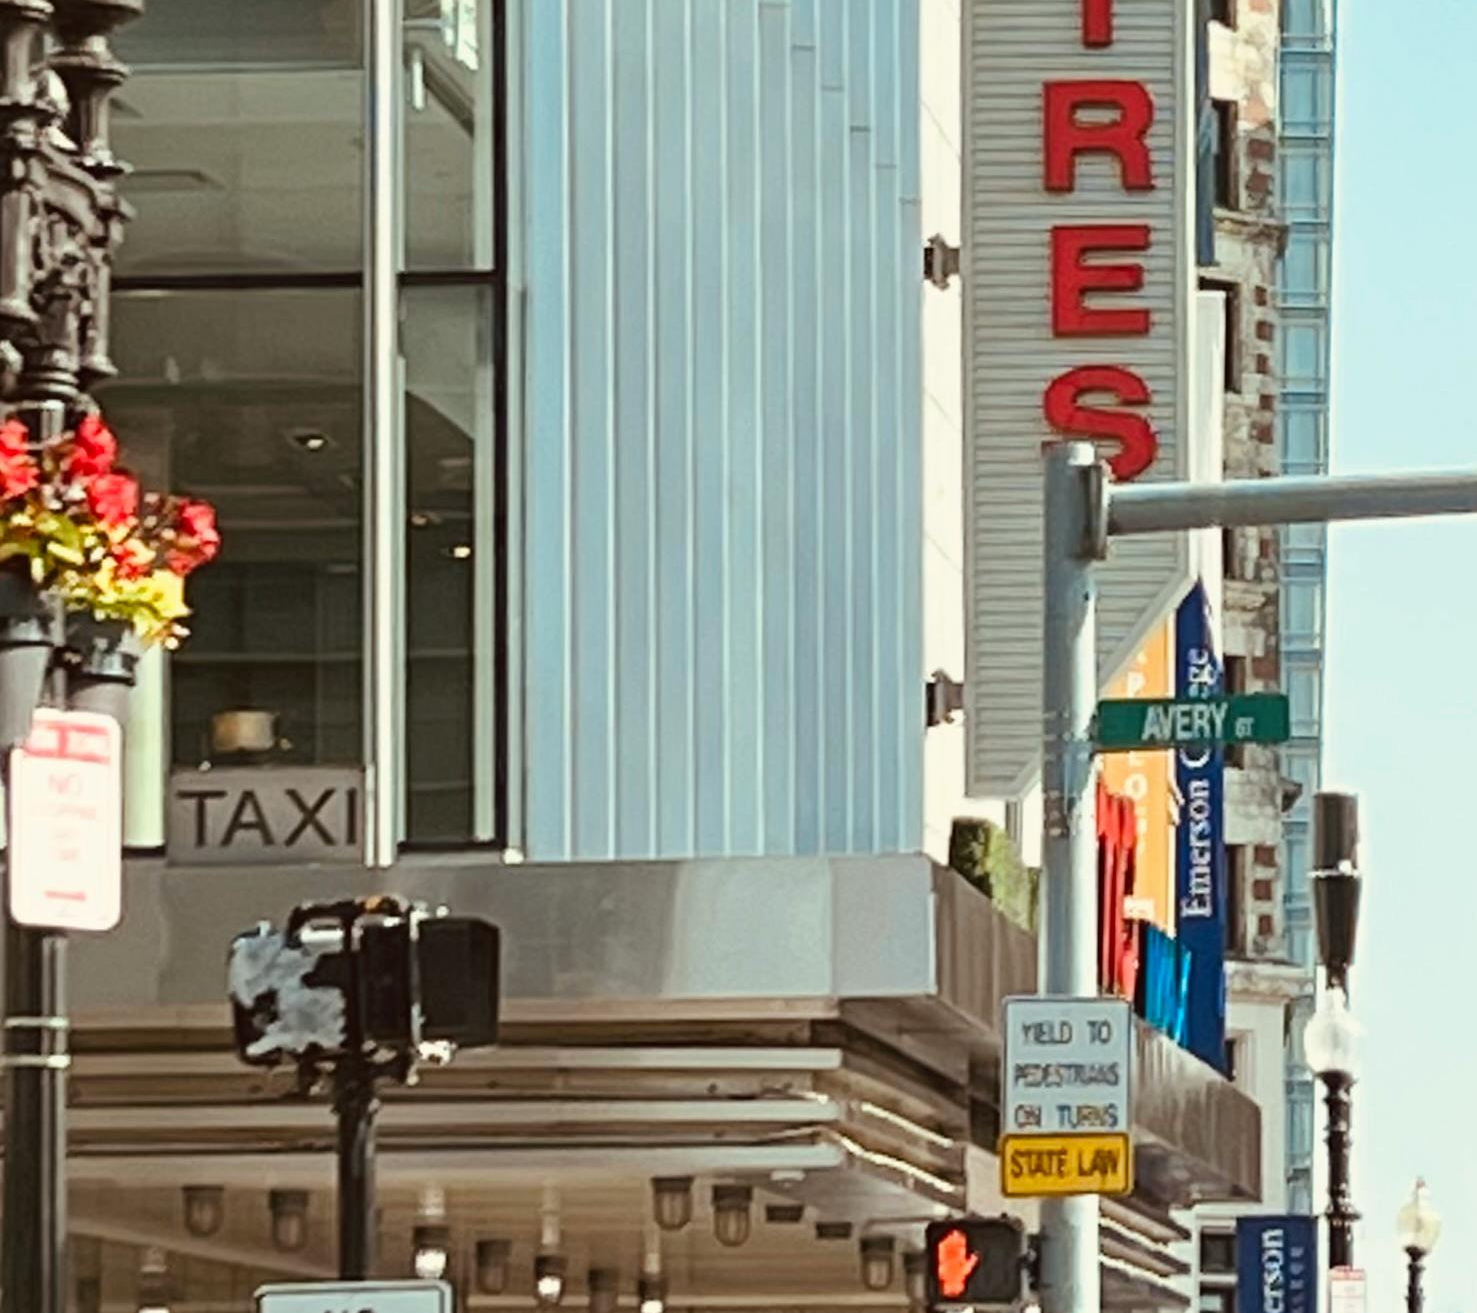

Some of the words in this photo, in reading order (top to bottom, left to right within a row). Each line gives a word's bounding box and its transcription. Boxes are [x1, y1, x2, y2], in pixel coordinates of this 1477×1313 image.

[1141, 703, 1228, 741] AVERY
[175, 788, 358, 848] TAXI
[1181, 779, 1213, 918] Emerson
[1022, 1020, 1073, 1044] YIELD
[1088, 1020, 1112, 1044] TO
[1014, 1104, 1042, 1128] ON
[1011, 1147, 1067, 1177] STATE
[1078, 1147, 1120, 1177] LAW
